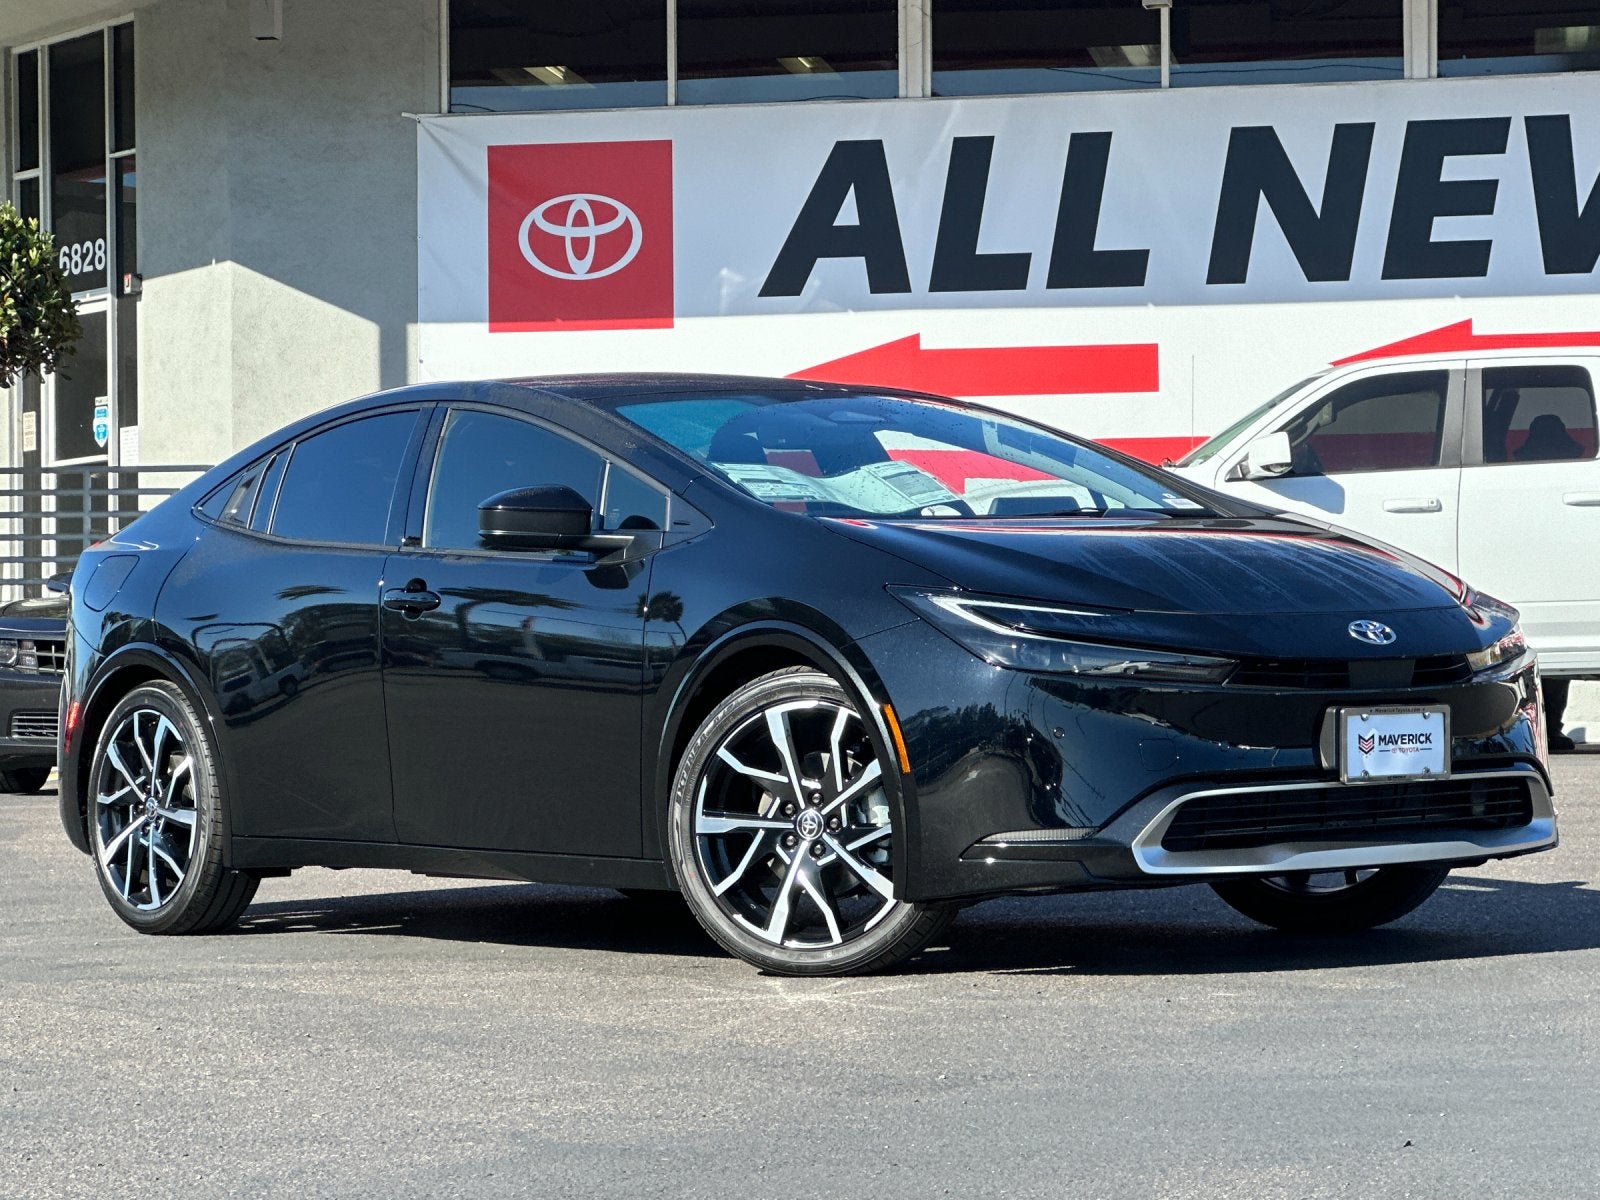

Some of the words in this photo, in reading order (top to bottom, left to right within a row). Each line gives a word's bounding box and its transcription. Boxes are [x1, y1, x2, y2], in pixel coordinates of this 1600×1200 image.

[757, 131, 1150, 297] ALL
[59, 238, 106, 277] 6828
[1378, 733, 1433, 746] MAVERICK
